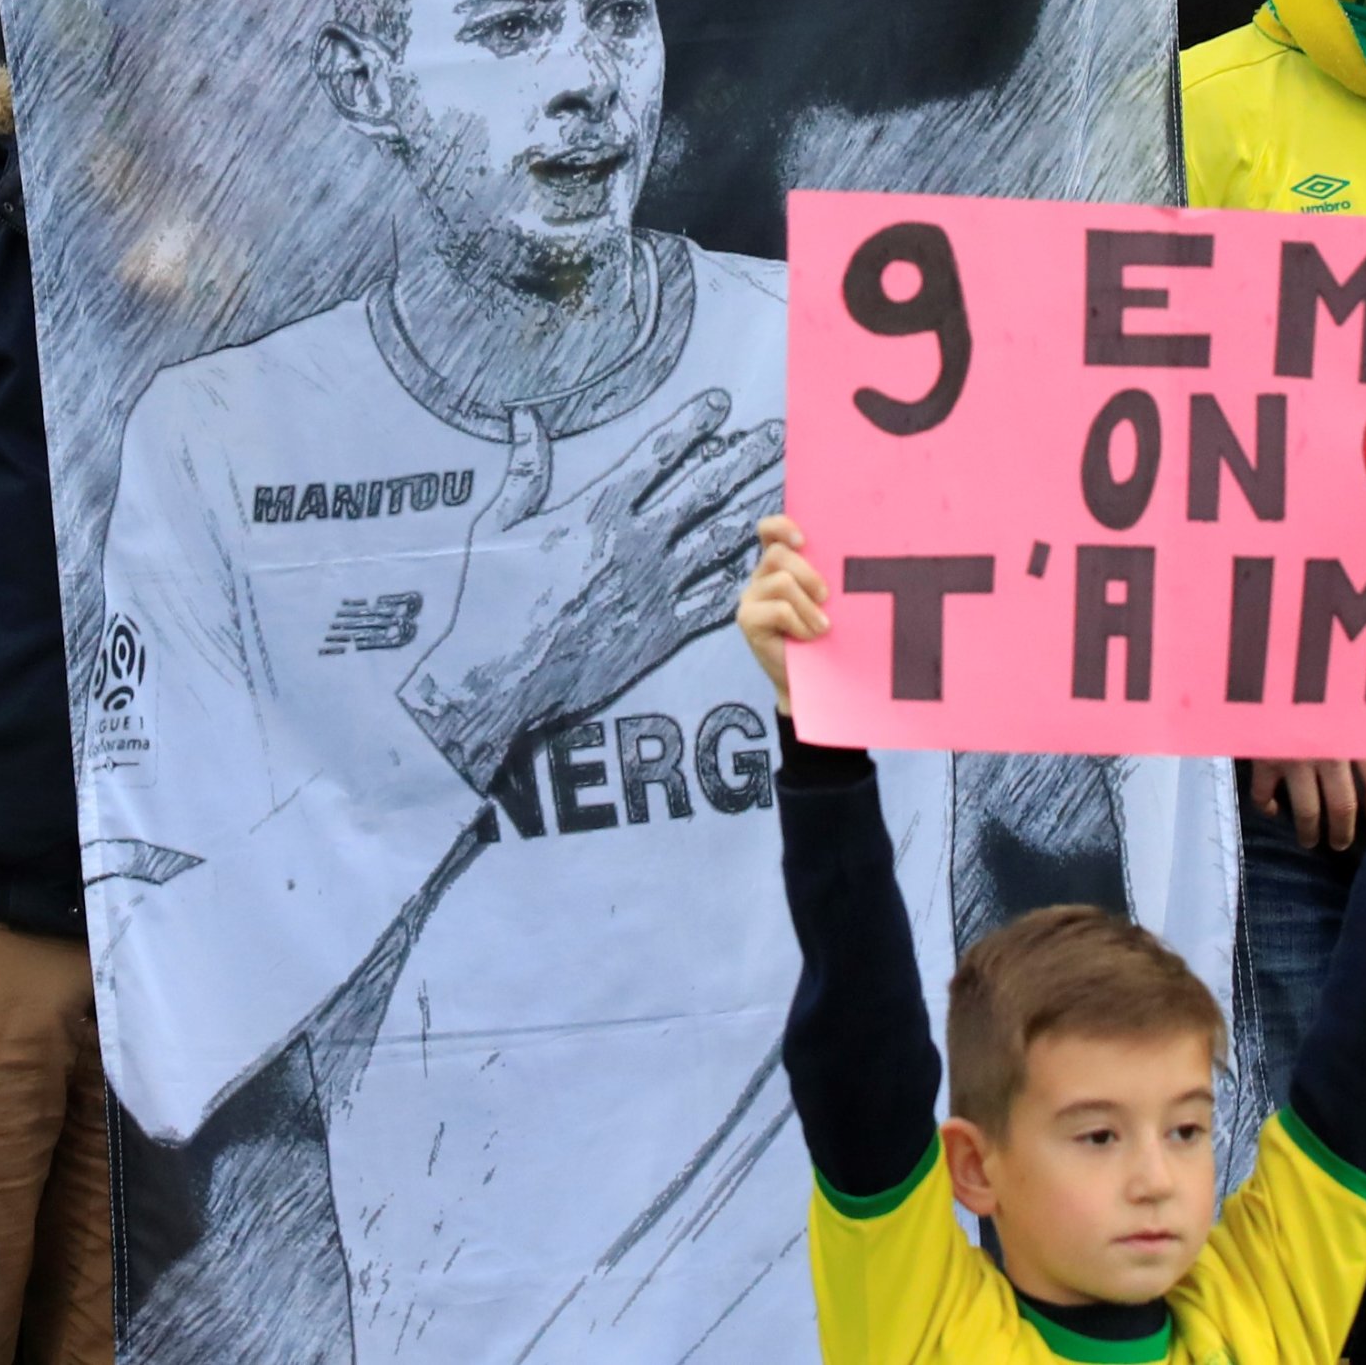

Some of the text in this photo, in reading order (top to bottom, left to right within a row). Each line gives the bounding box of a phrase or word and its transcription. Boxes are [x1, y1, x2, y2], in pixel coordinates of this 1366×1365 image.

[1300, 200, 1351, 214] umbro
[842, 222, 972, 436] 9
[251, 470, 475, 524] MANITOU
[1080, 388, 1288, 531] ON
